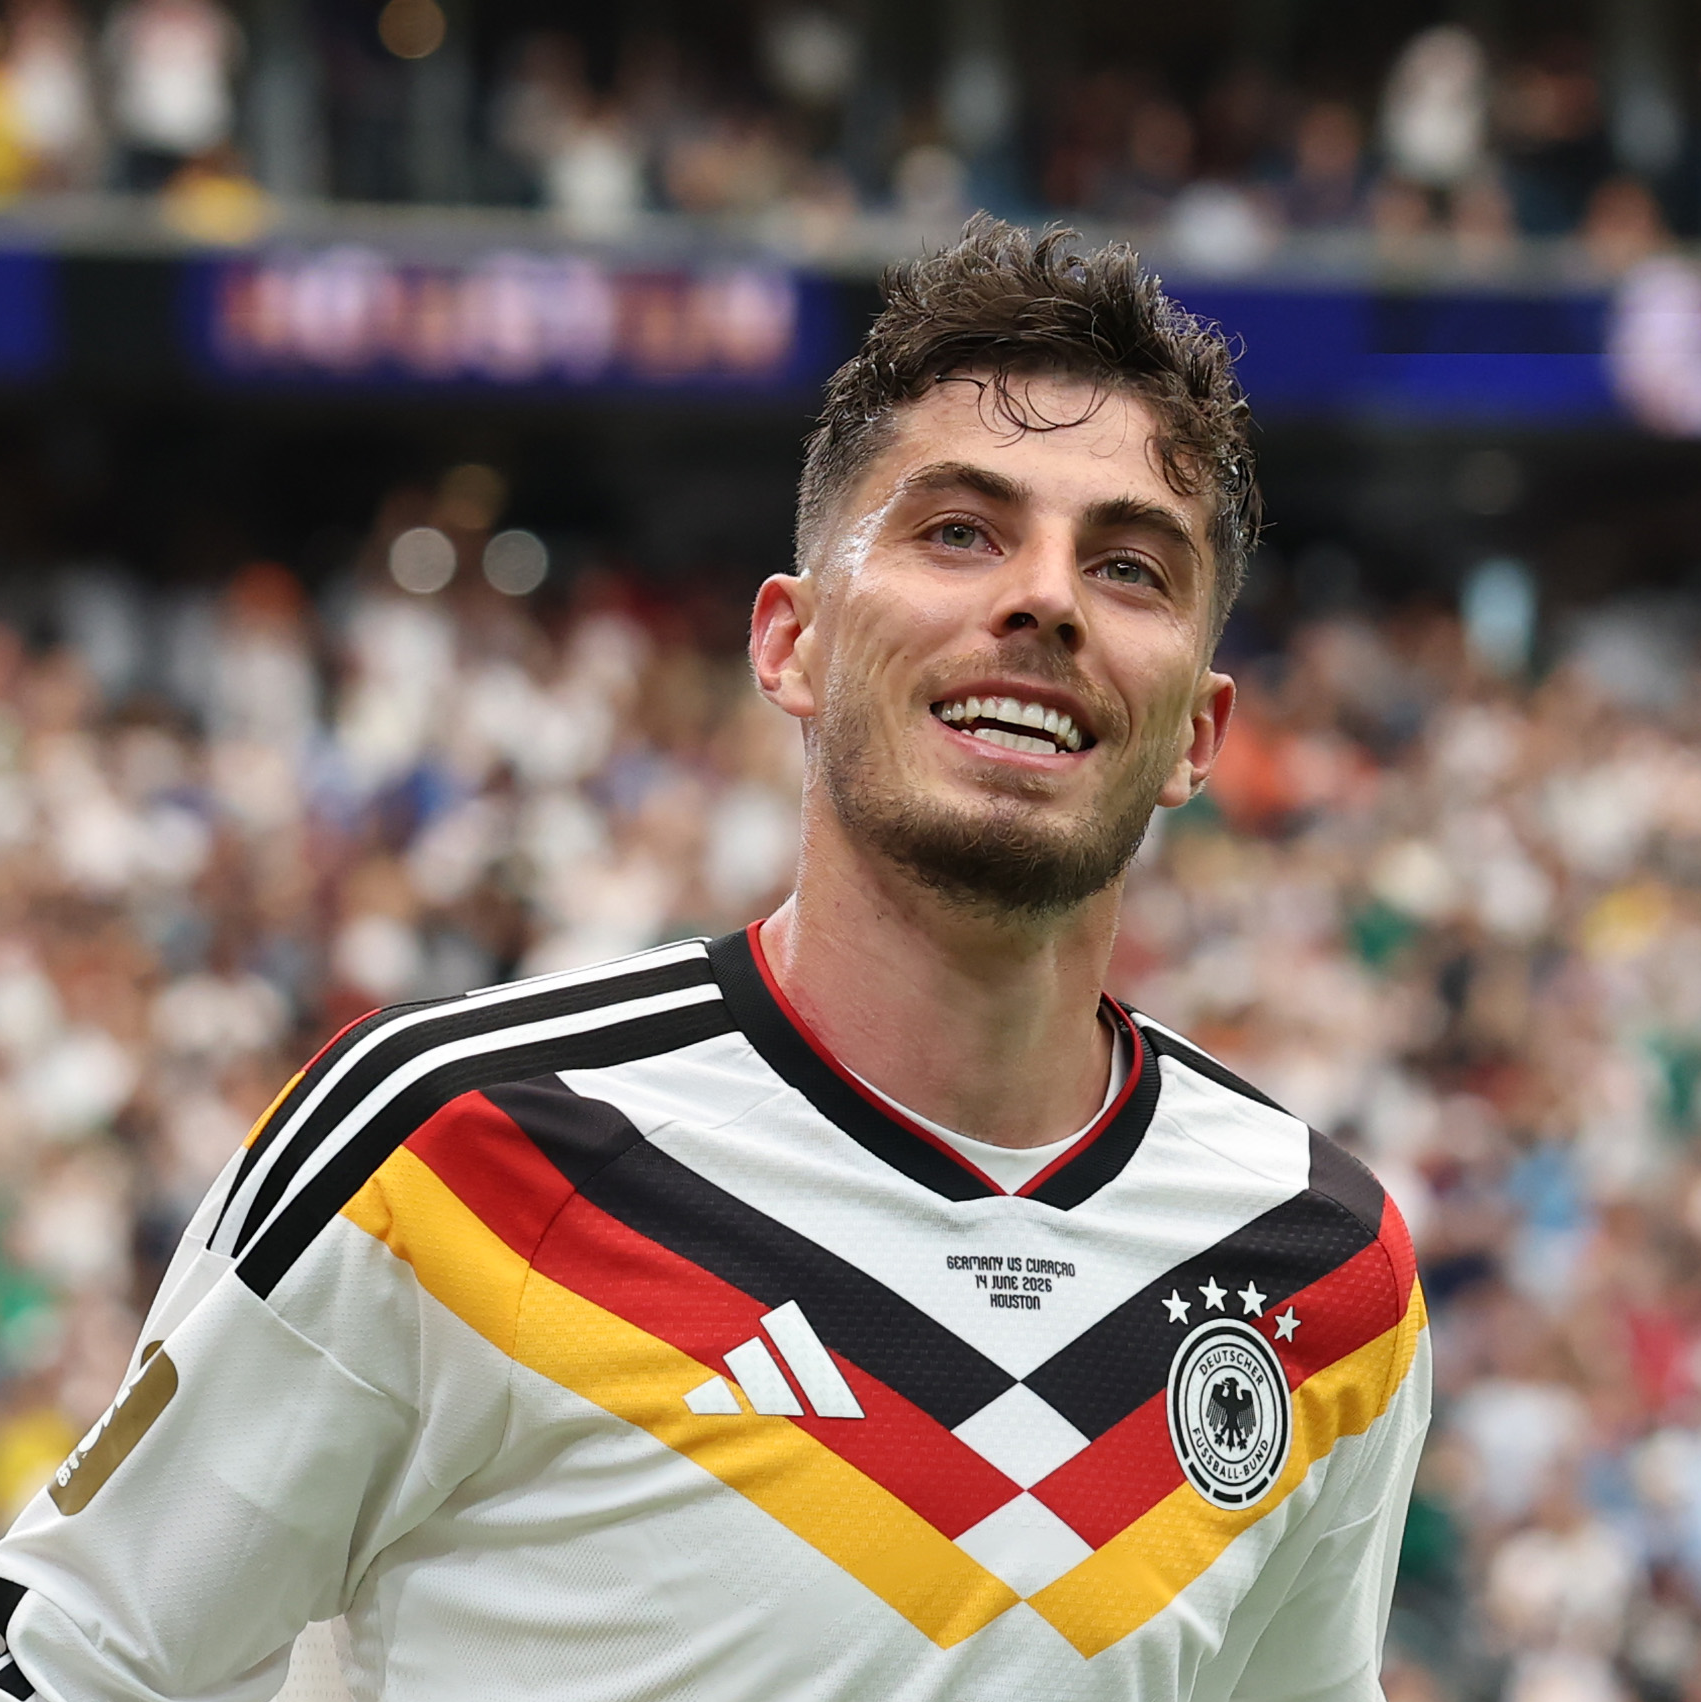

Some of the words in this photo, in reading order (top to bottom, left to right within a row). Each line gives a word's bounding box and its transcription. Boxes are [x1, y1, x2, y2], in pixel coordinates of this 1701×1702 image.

[946, 1255, 1004, 1271] GERMANY
[1026, 1258, 1076, 1278] CURAÇAO
[975, 1274, 988, 1289] 14
[991, 1275, 1019, 1290] JUNE
[1022, 1276, 1053, 1292] 2026
[990, 1293, 1041, 1310] HOUSTON
[1199, 1349, 1264, 1387] DEUTSCHER
[1191, 1427, 1269, 1480] FUSSBALL-BUND
